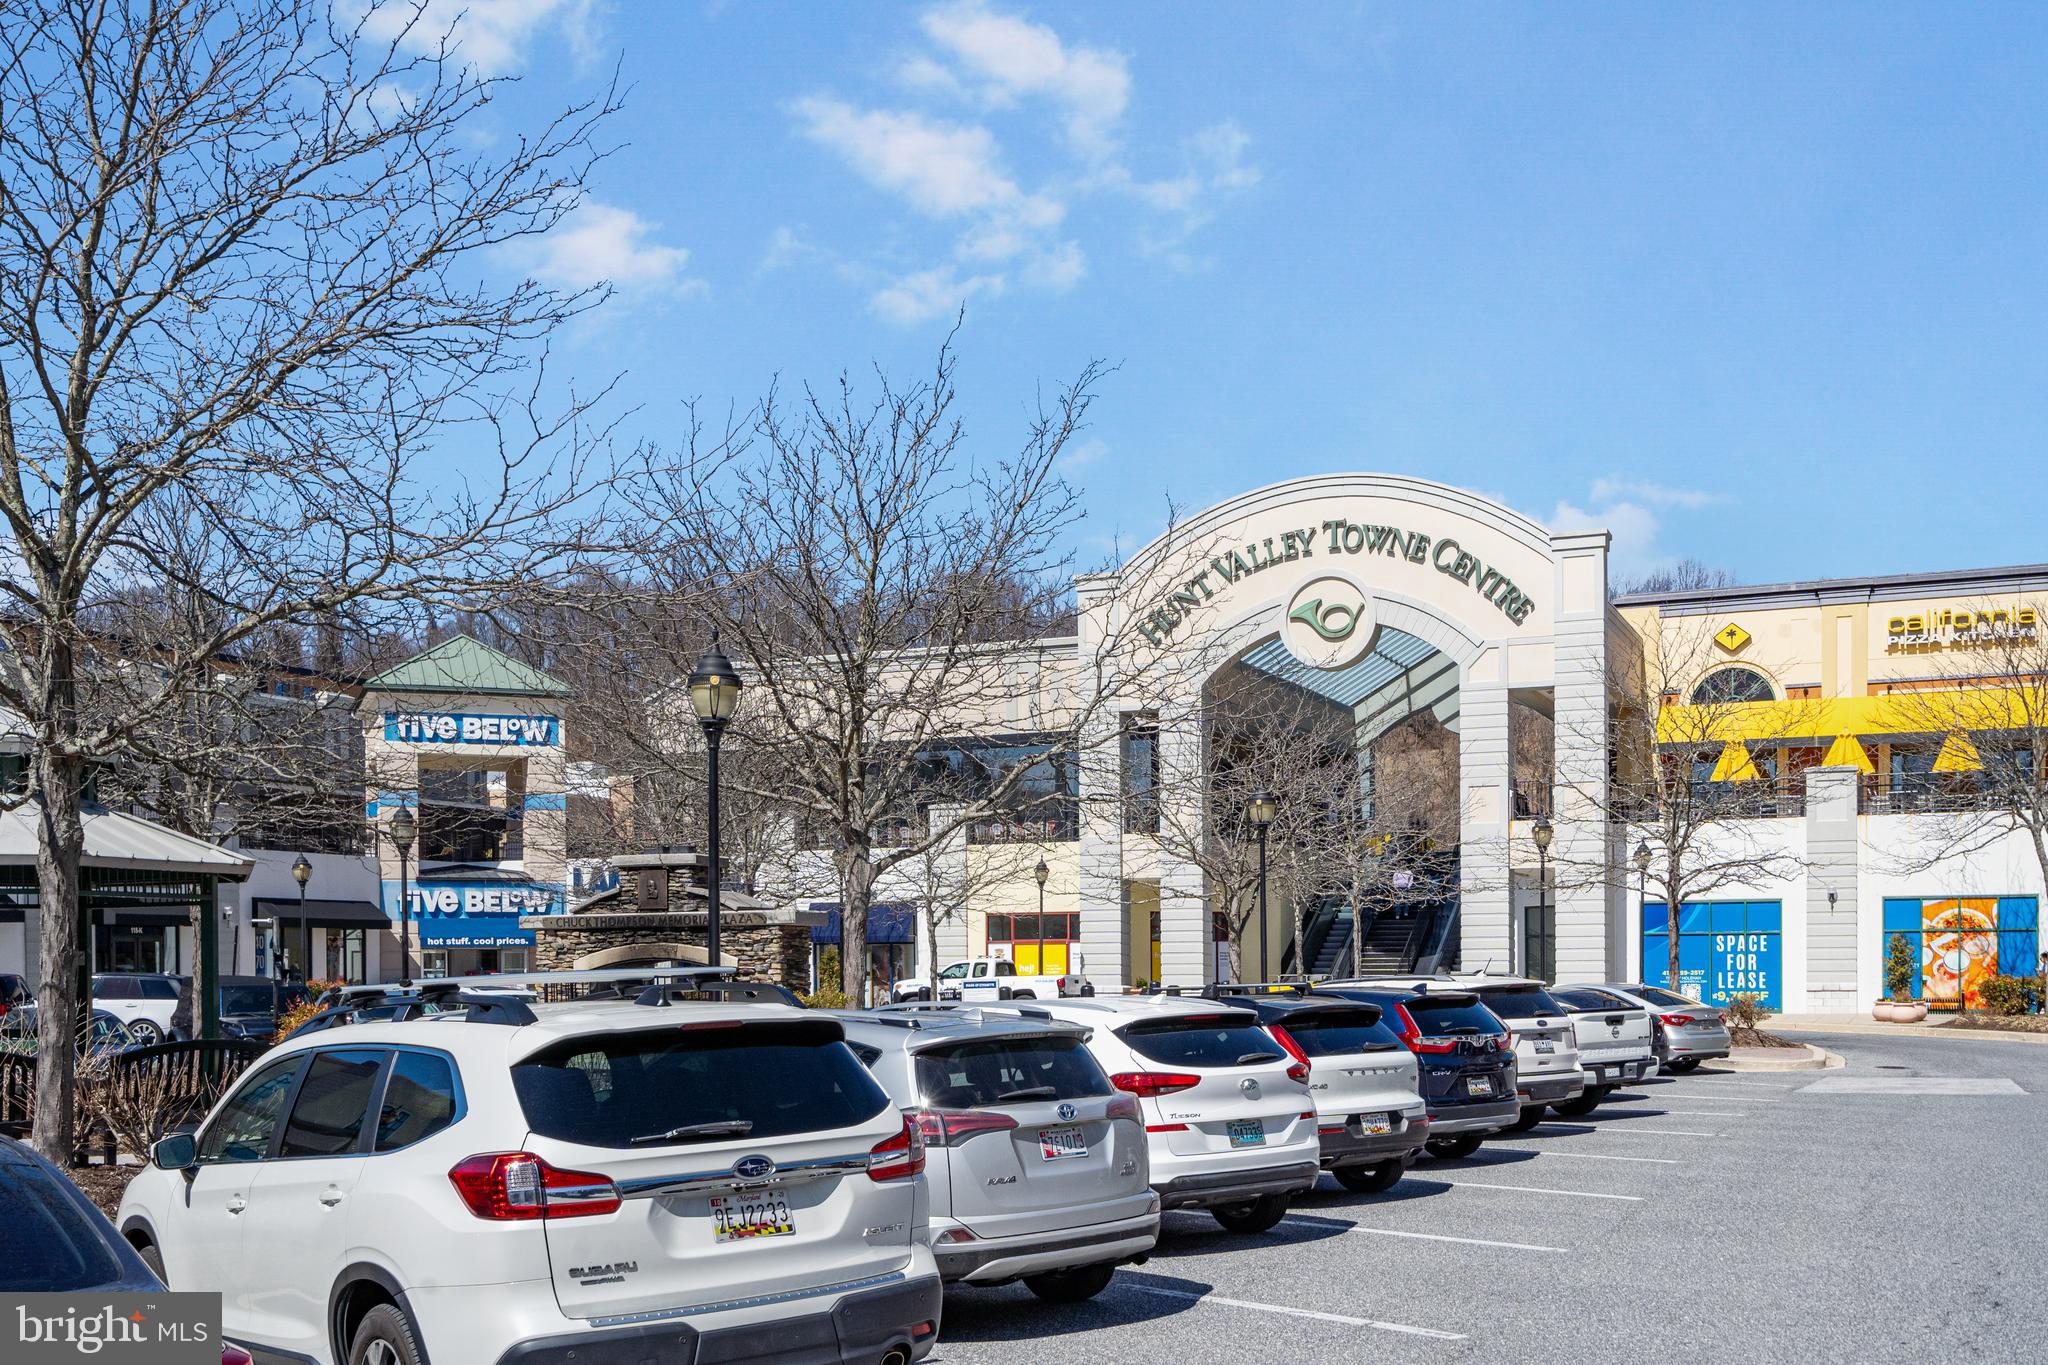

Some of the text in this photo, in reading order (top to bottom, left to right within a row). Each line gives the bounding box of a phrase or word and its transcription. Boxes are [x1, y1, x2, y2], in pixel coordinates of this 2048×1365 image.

[1210, 526, 1317, 584] VALLEY
[1322, 517, 1431, 562] TOWNE
[1432, 537, 1536, 627] CENTRE
[1888, 603, 2036, 633] california
[1887, 633, 1941, 646] PIZZA
[397, 716, 457, 740] five
[556, 916, 593, 928] CHUCK
[658, 914, 709, 927] MEMORIA
[427, 936, 529, 947] hot stuff. cool prices.
[1716, 934, 1768, 952] SPACE
[1726, 953, 1757, 971] FOR
[1718, 971, 1767, 989] LEASE
[715, 1201, 789, 1234] 9EJ2233
[568, 1260, 639, 1279] SUBARU
